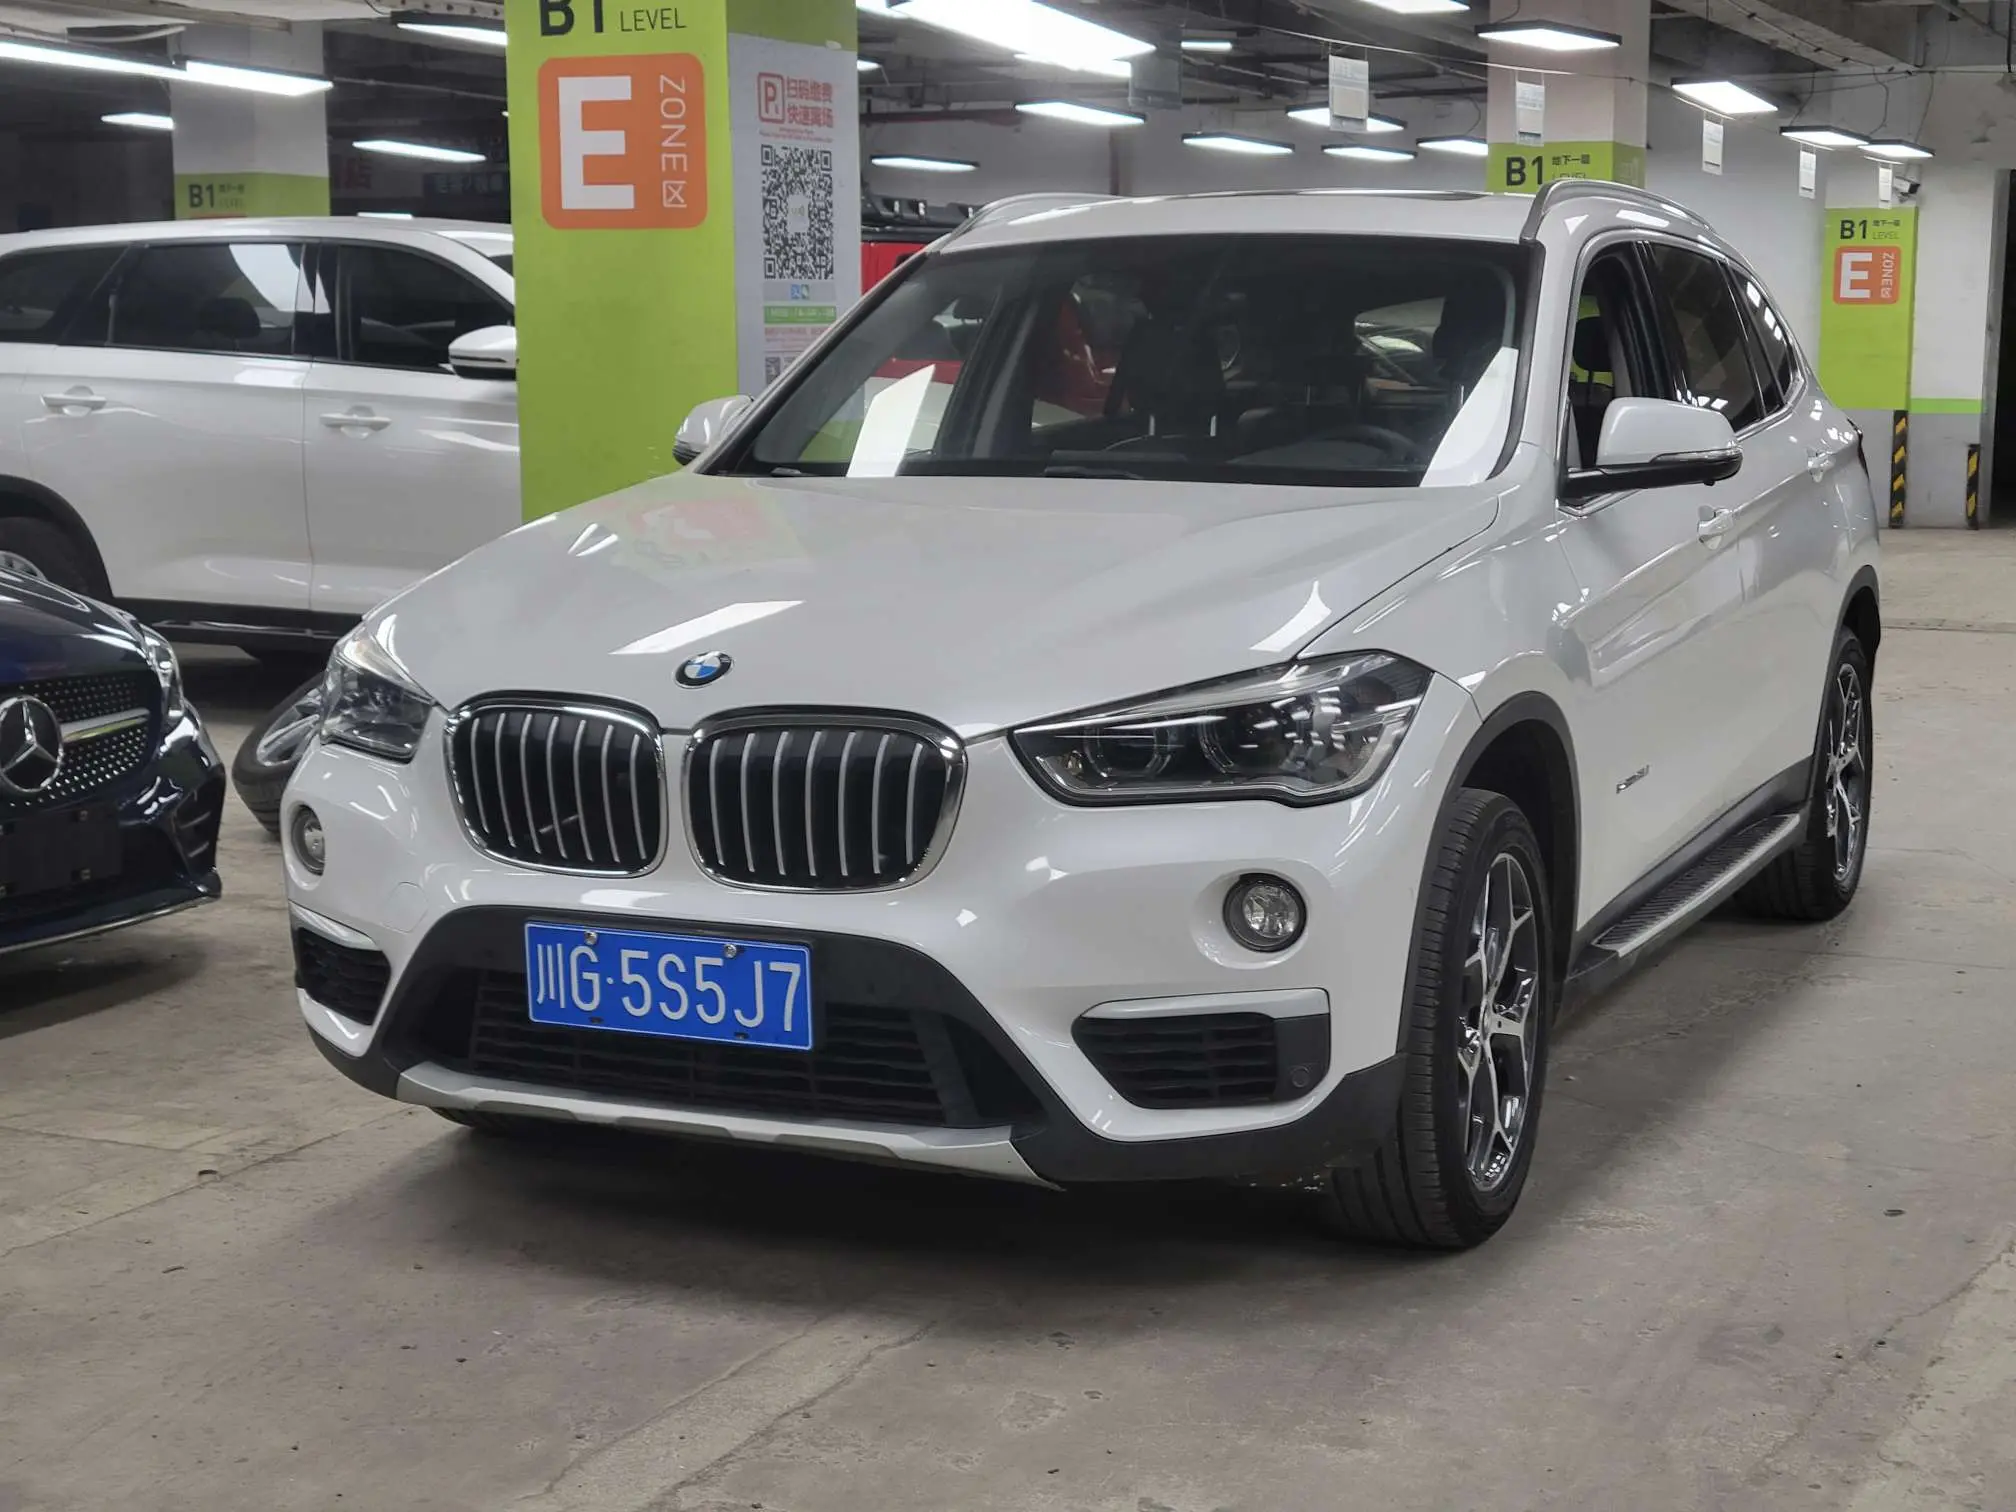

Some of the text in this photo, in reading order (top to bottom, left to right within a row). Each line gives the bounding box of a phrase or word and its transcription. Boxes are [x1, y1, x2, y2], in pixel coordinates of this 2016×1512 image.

[620, 7, 687, 32] LEVEL
[558, 75, 635, 210] E
[659, 74, 688, 209] ZONE 区
[1505, 155, 1544, 186] B1
[188, 183, 215, 208] B1
[1839, 219, 1868, 240] B1
[1839, 251, 1873, 299] E
